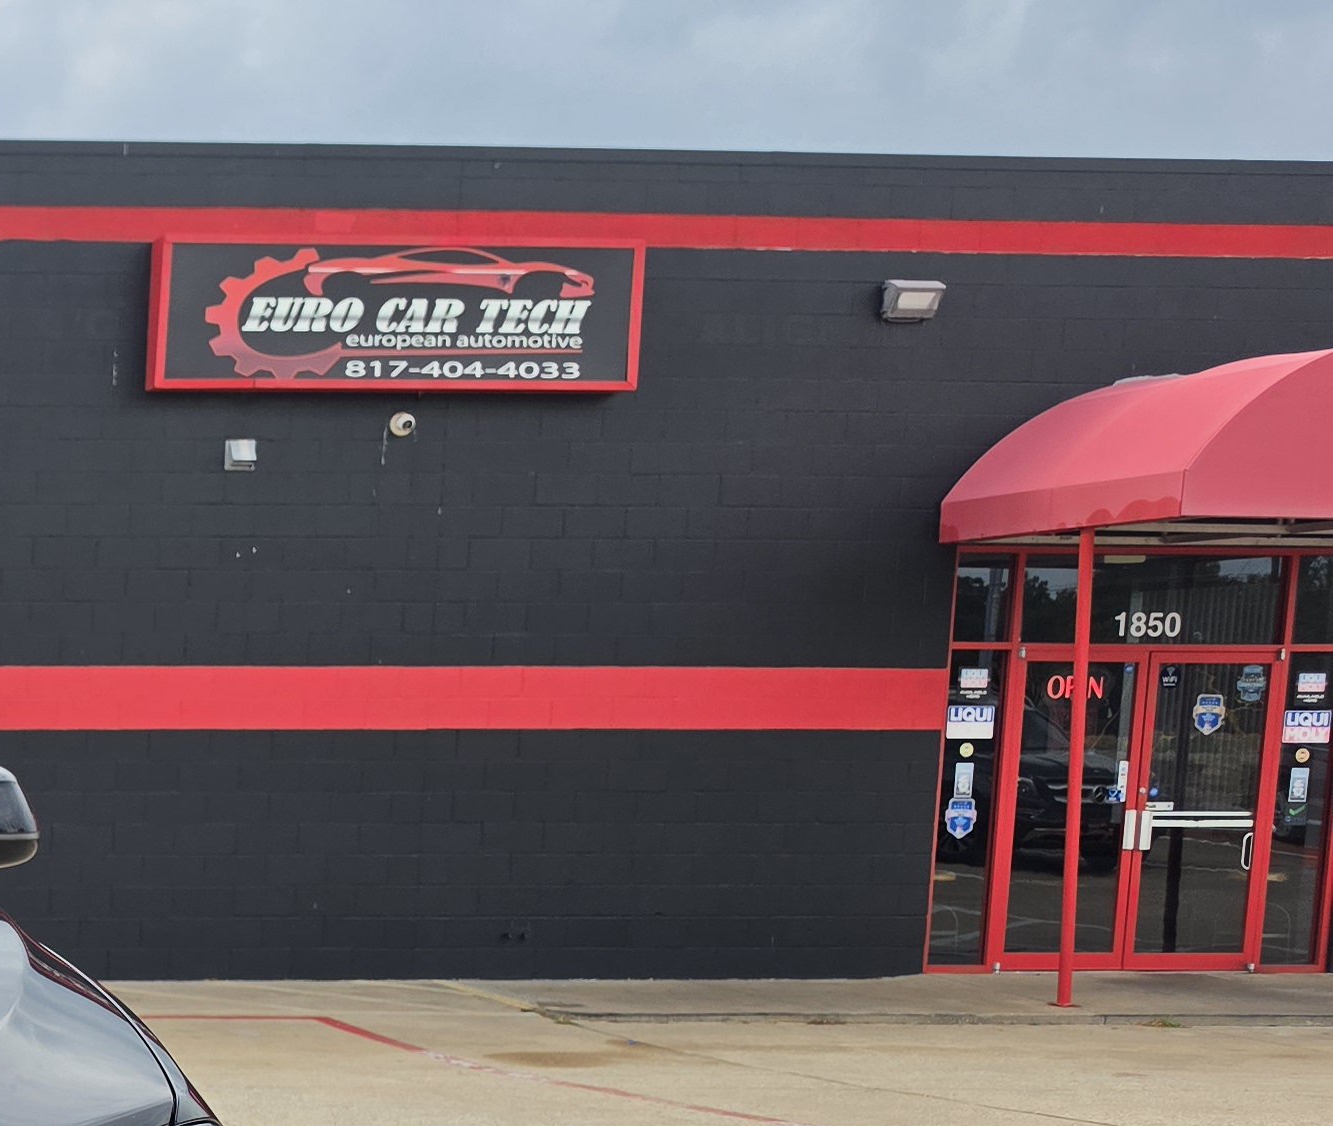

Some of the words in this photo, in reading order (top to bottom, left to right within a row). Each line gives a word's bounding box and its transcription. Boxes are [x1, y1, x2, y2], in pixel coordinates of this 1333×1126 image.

[242, 296, 365, 333] EURO
[375, 297, 466, 334] CAR
[476, 299, 593, 335] TECH
[345, 331, 451, 350] european
[456, 331, 583, 349] automotive
[344, 359, 581, 380] 817-404-4033
[1114, 611, 1182, 638] 1850
[1046, 674, 1104, 699] OPN
[949, 706, 993, 722] LIQUI
[1286, 712, 1329, 727] LIQUI
